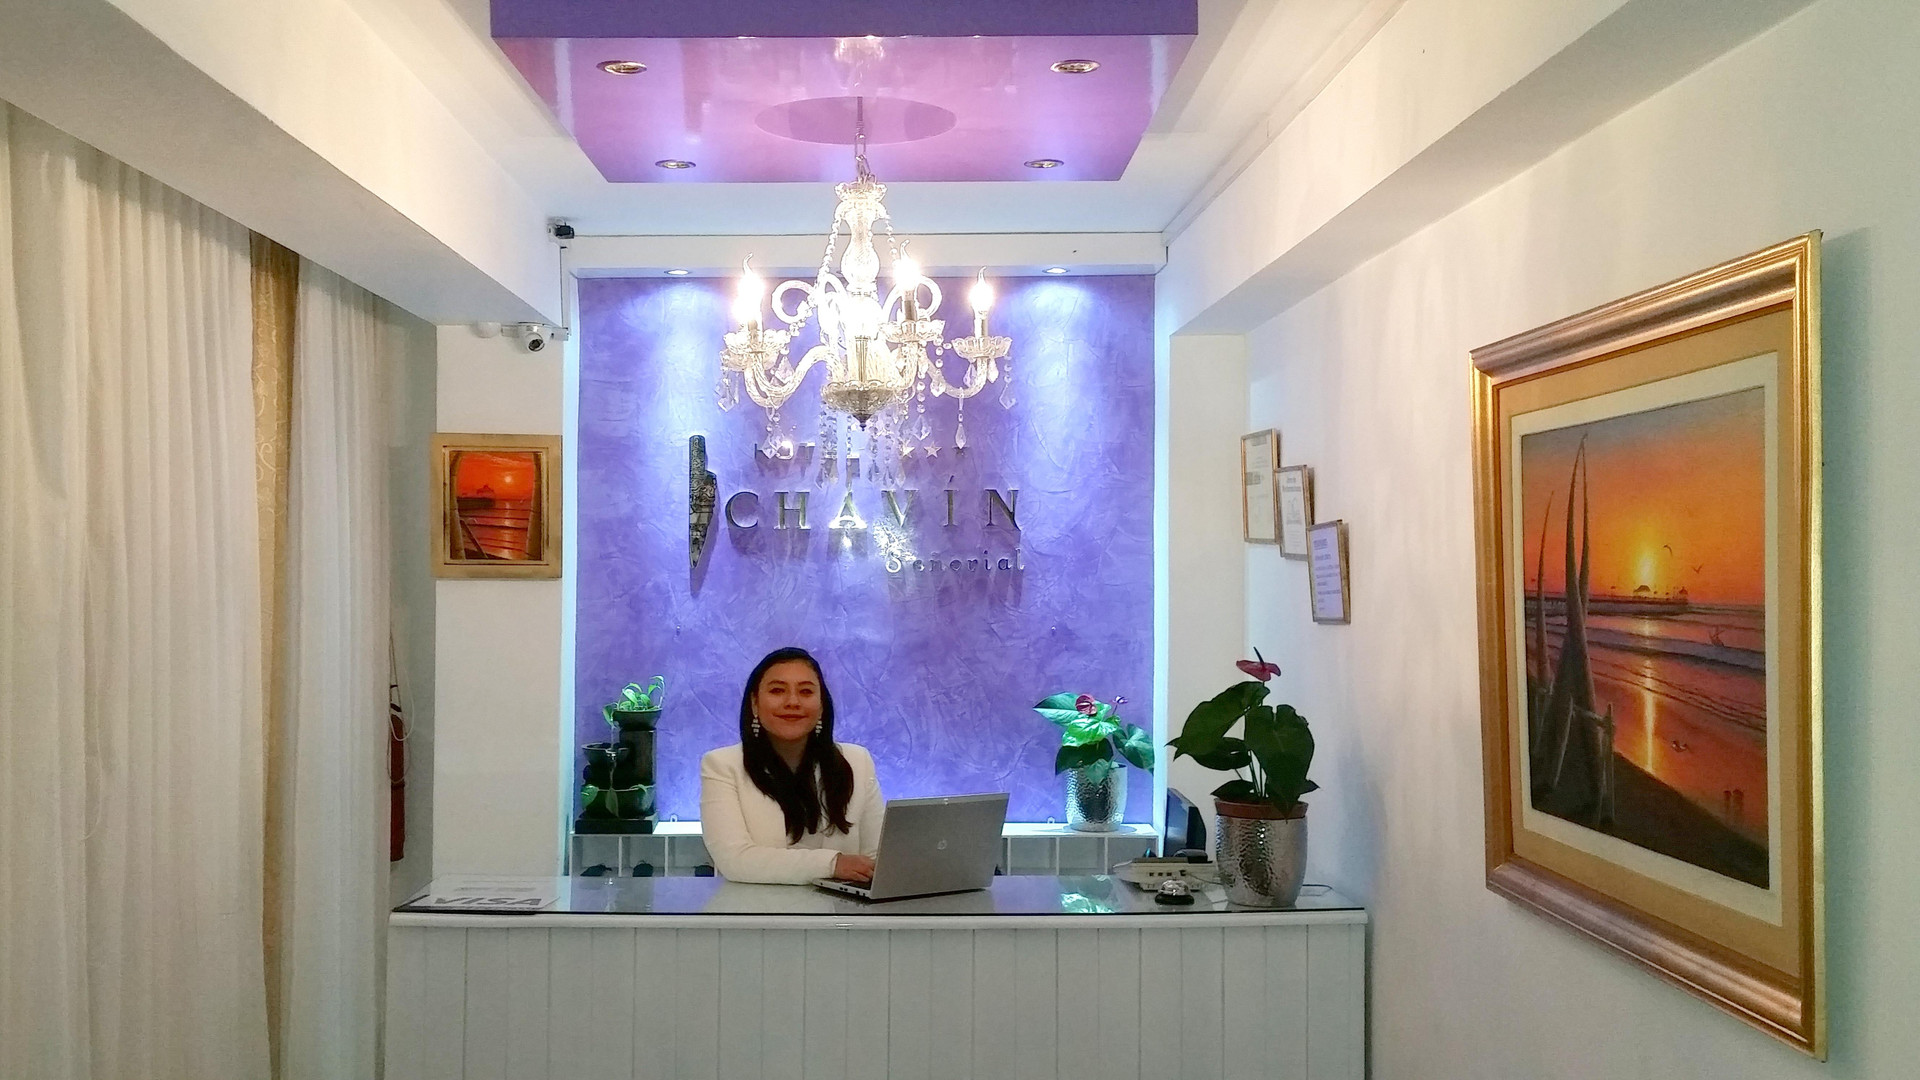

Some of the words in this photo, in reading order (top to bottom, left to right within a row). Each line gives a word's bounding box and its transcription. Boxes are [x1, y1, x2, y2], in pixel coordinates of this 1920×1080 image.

[725, 475, 1021, 532] CHAVÍN
[885, 547, 1025, 573] Señorial
[434, 896, 542, 906] VISA
